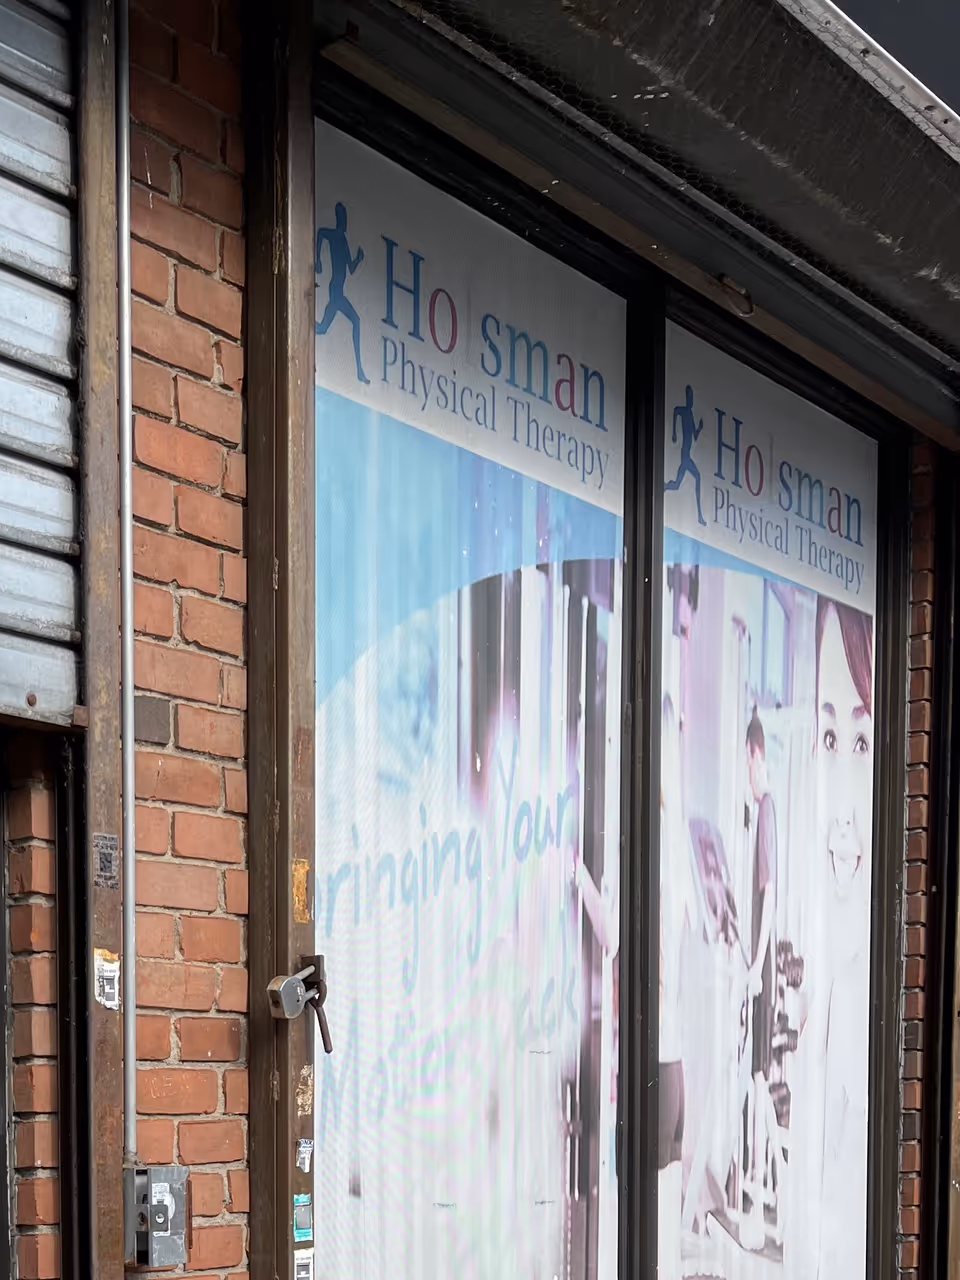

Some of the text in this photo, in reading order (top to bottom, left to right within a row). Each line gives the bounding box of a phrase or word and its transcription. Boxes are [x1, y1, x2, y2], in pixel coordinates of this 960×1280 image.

[381, 335, 609, 490] Physical Therapy
[713, 486, 865, 595] Physical Therapy
